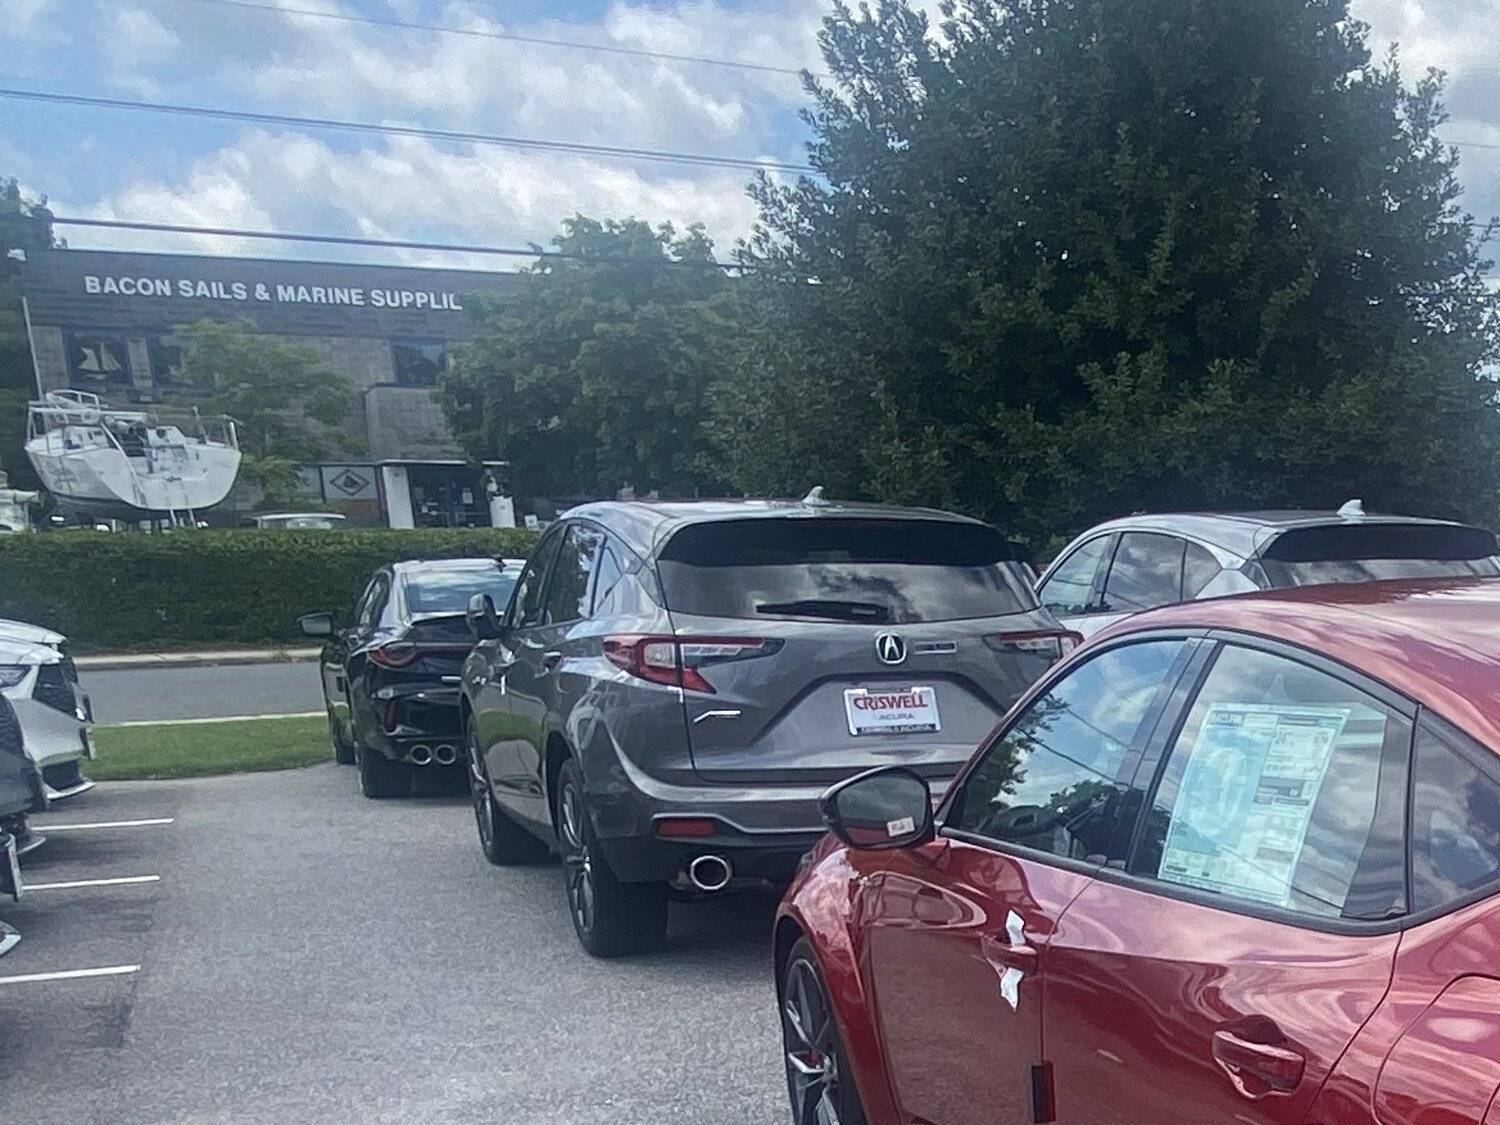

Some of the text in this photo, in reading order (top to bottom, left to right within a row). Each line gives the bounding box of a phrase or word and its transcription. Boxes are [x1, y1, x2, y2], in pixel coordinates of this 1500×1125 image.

[84, 275, 172, 297] BACON
[178, 279, 248, 301] SAILS
[254, 282, 271, 302] &
[277, 284, 365, 307] MARINE
